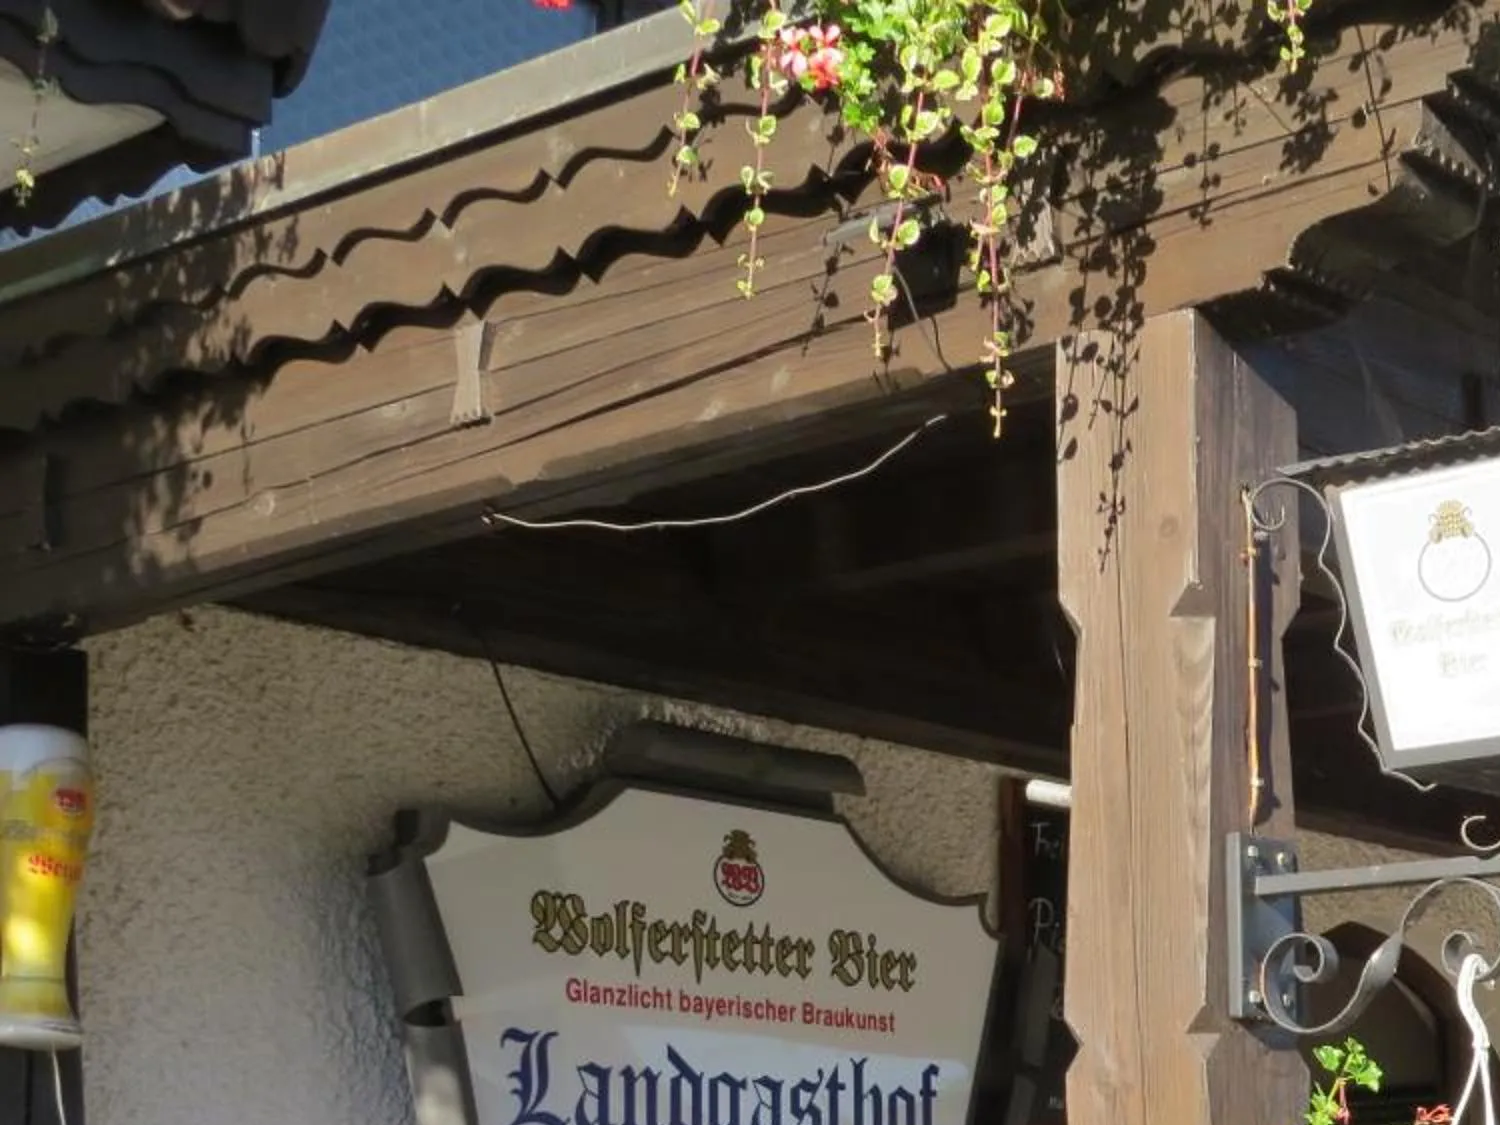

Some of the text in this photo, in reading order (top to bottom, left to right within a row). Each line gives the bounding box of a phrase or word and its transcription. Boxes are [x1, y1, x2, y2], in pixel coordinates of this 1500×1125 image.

[828, 929, 918, 993] Bier
[565, 978, 896, 1034] Glanzlicht bayerischer Braukunst
